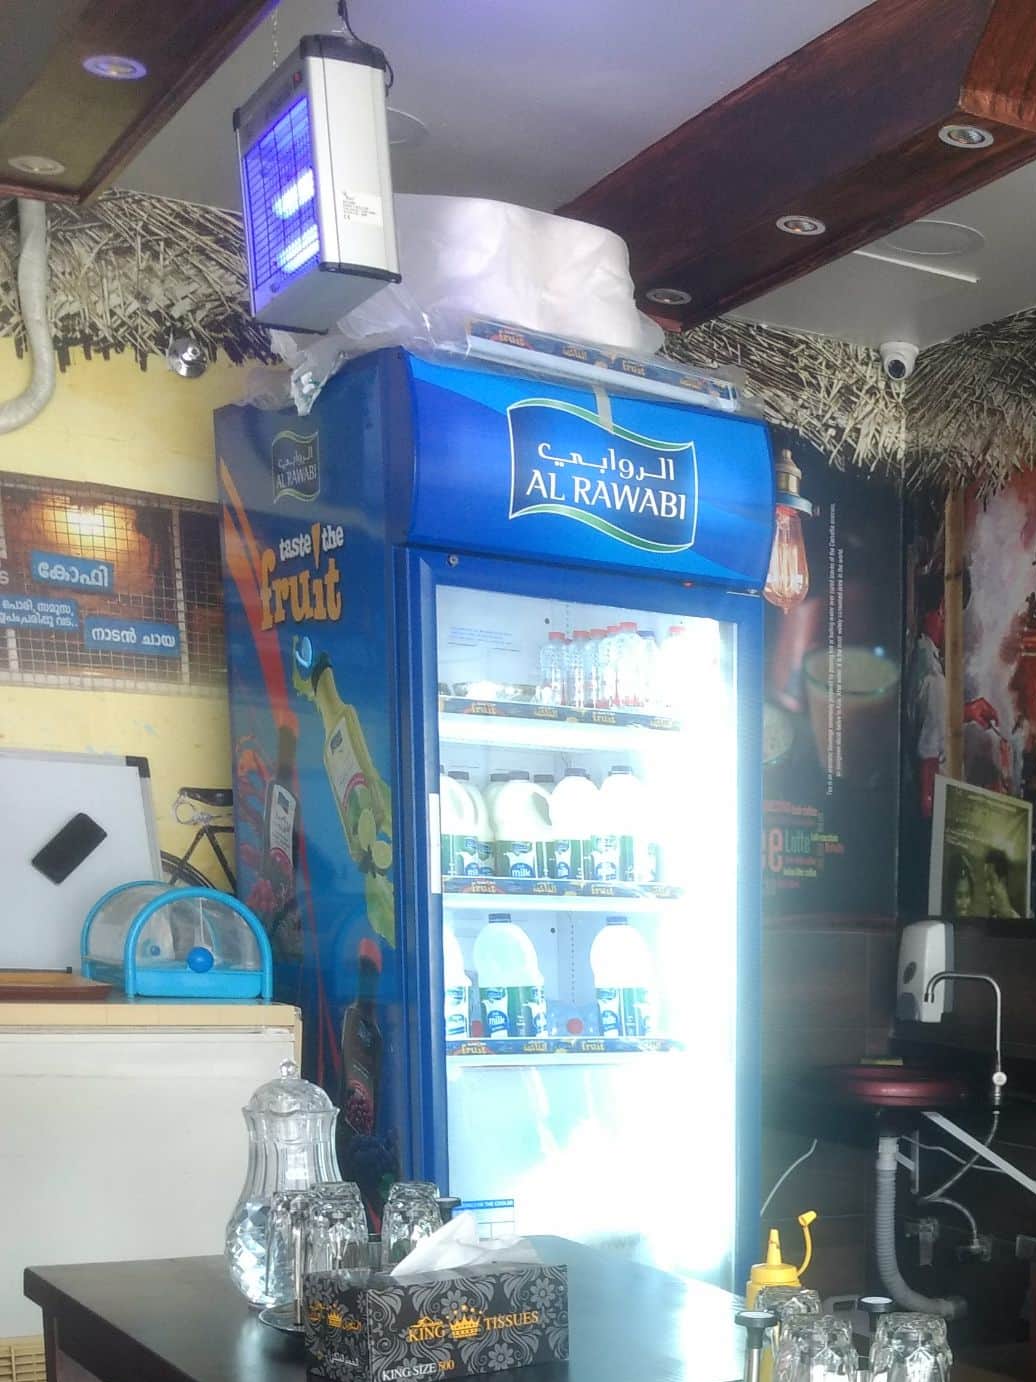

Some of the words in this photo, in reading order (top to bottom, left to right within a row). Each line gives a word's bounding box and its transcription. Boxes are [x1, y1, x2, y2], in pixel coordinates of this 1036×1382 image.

[287, 463, 317, 487] RAWABI
[537, 442, 675, 481] الروابي
[526, 469, 566, 502] AL
[572, 475, 687, 520] RAWABI
[279, 533, 312, 561] taste
[321, 524, 344, 552] the
[38, 562, 109, 588] കോഫി
[261, 549, 342, 631] fruit
[512, 866, 531, 876] milk
[407, 1324, 446, 1343] KING
[484, 1311, 540, 1332] TISSUES
[382, 1368, 412, 1381] KING
[412, 1363, 437, 1376] SIZE
